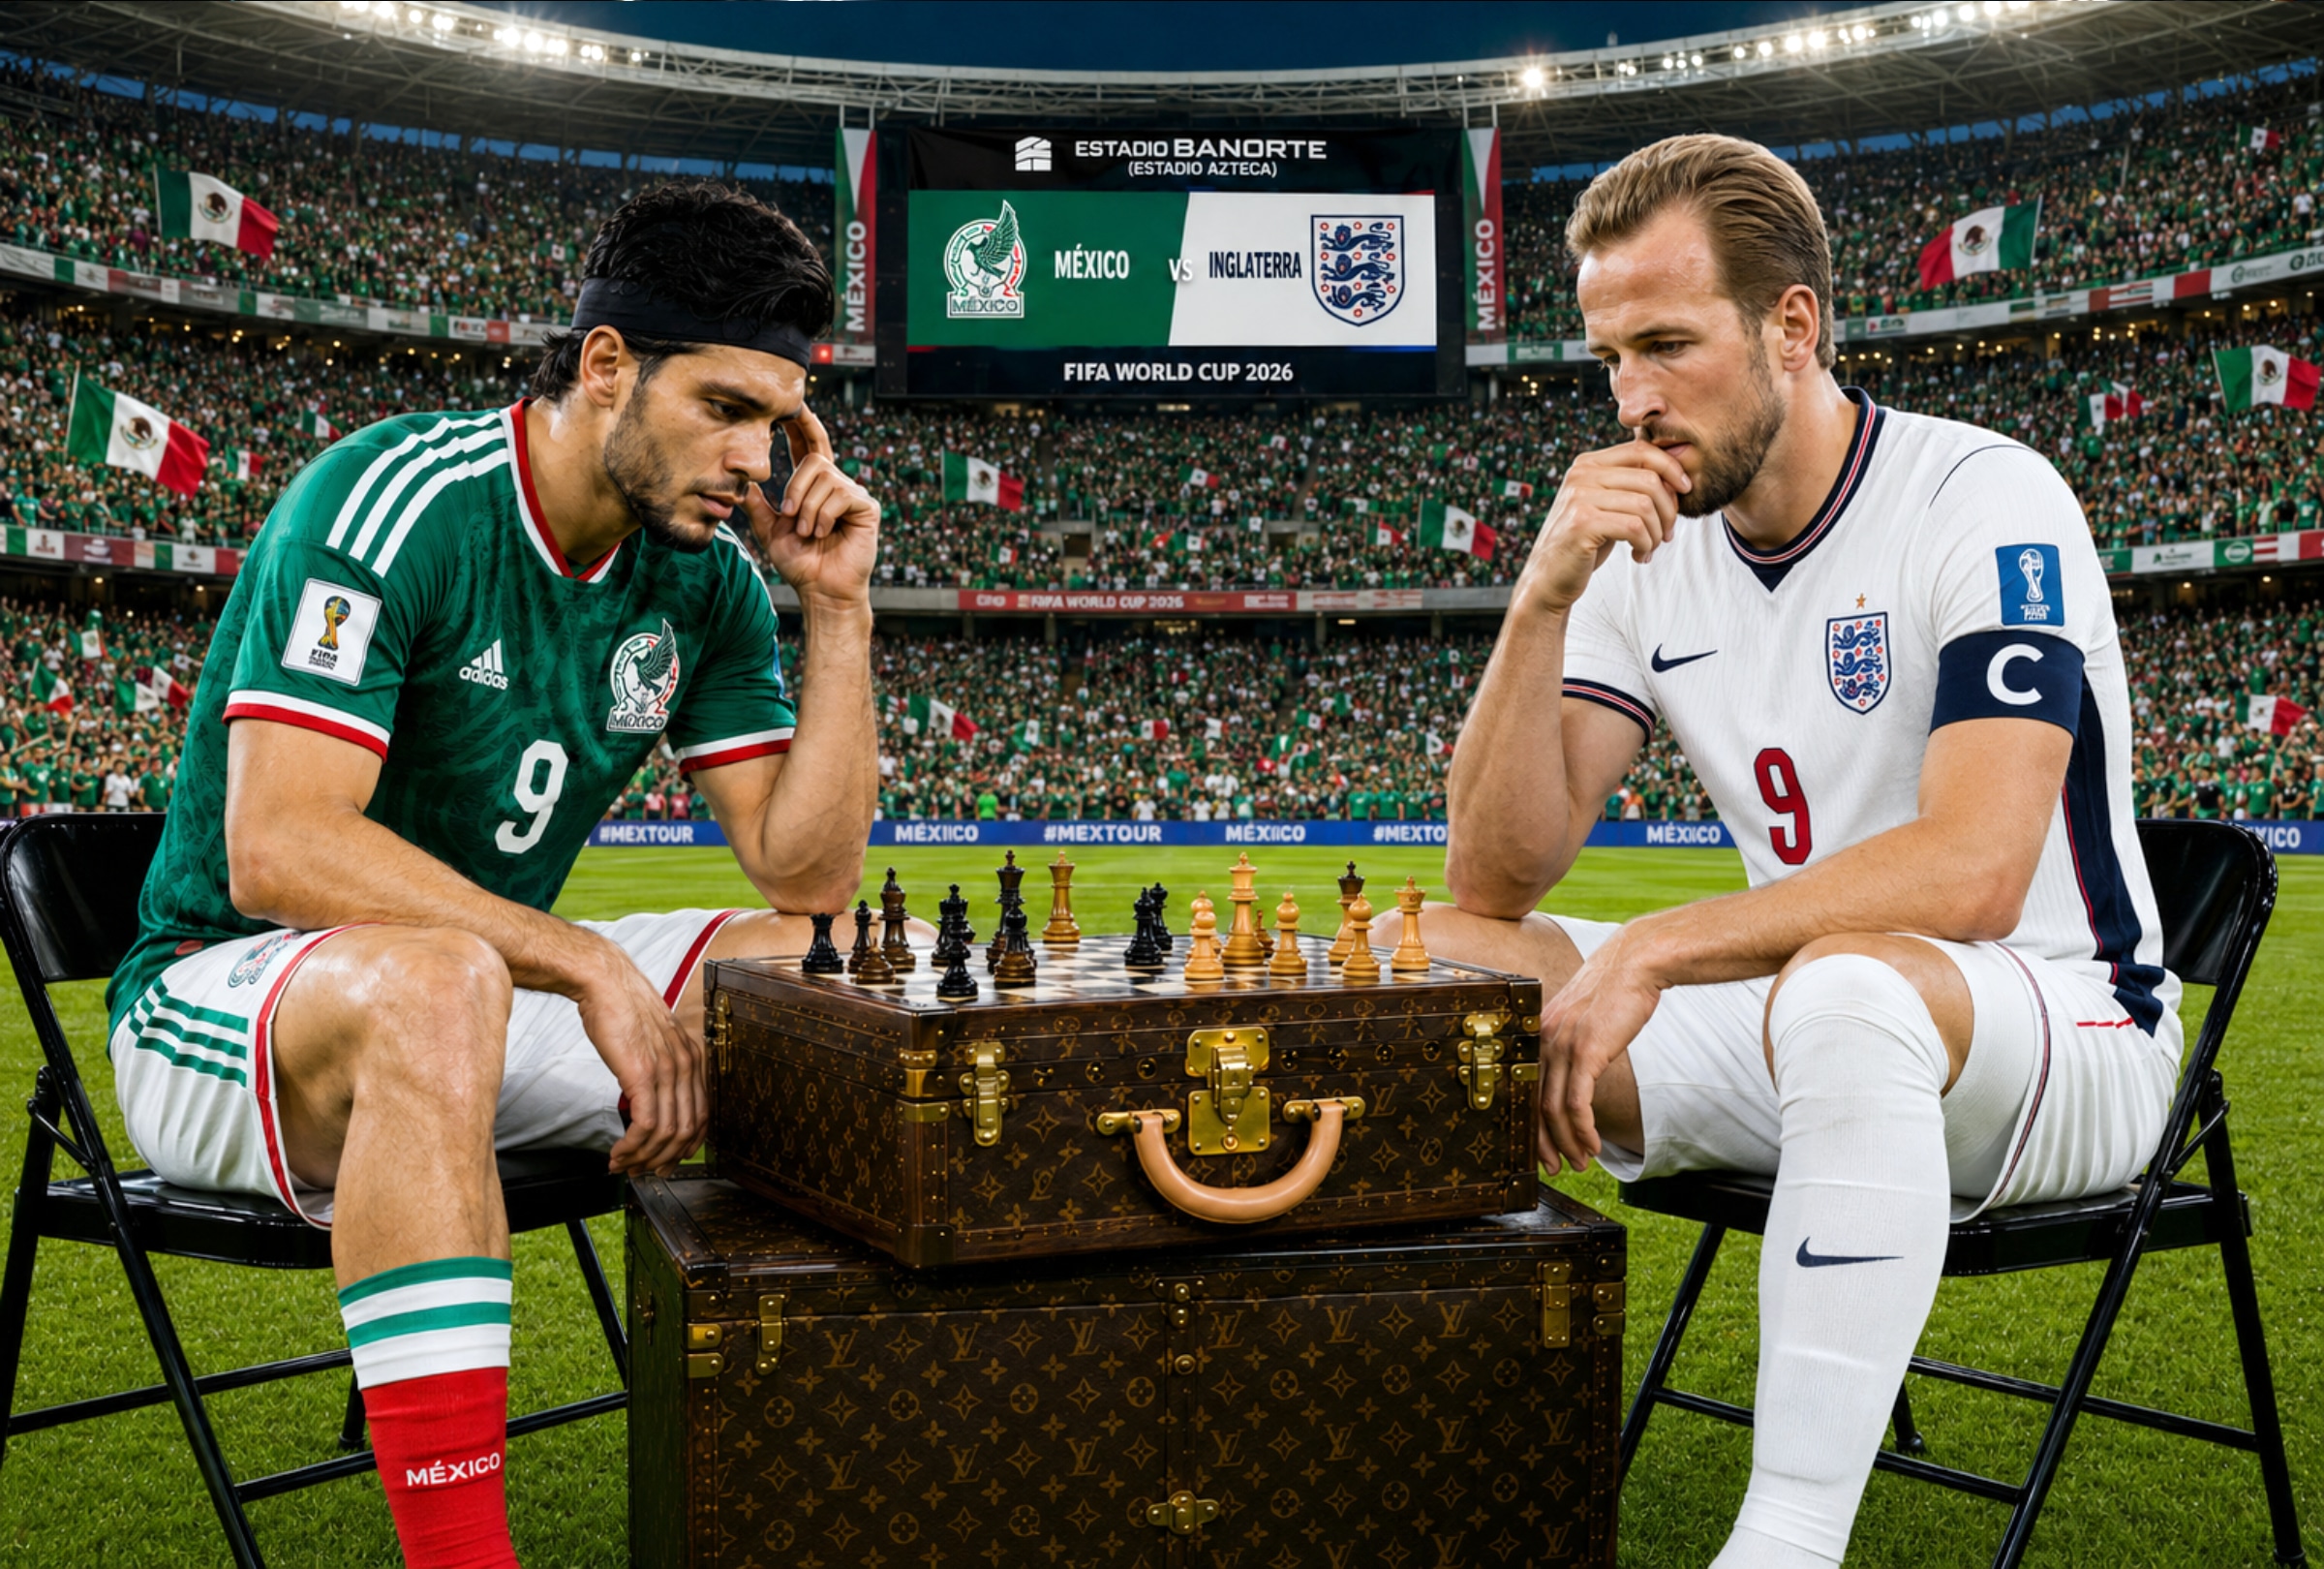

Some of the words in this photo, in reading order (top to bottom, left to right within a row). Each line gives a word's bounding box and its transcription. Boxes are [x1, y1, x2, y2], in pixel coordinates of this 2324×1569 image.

[1075, 140, 1169, 157] ESTADIO
[1173, 138, 1327, 159] BANORTE
[1128, 161, 1203, 176] (ESTADIO
[1208, 161, 1277, 177] AZTECA)
[1054, 244, 1129, 279] MÉXICO
[1208, 251, 1302, 279] INGLATERRA
[1472, 219, 1496, 331] MÉXICO
[1064, 362, 1111, 382] FIFA
[1116, 362, 1193, 382] WORLD
[1198, 362, 1240, 382] CUP
[1245, 362, 1294, 382] 2026
[1067, 595, 1116, 608] WORLD
[1119, 595, 1147, 608] CUP
[458, 665, 508, 691] adidas
[1986, 643, 2044, 706] C
[495, 739, 569, 854] 9
[1754, 748, 1812, 865] 9
[599, 824, 693, 843] #MEXTOUR
[1044, 824, 1161, 843] #MEXTOUR
[1373, 824, 1447, 842] #MEXTO
[406, 1452, 501, 1487] MÉXICO
